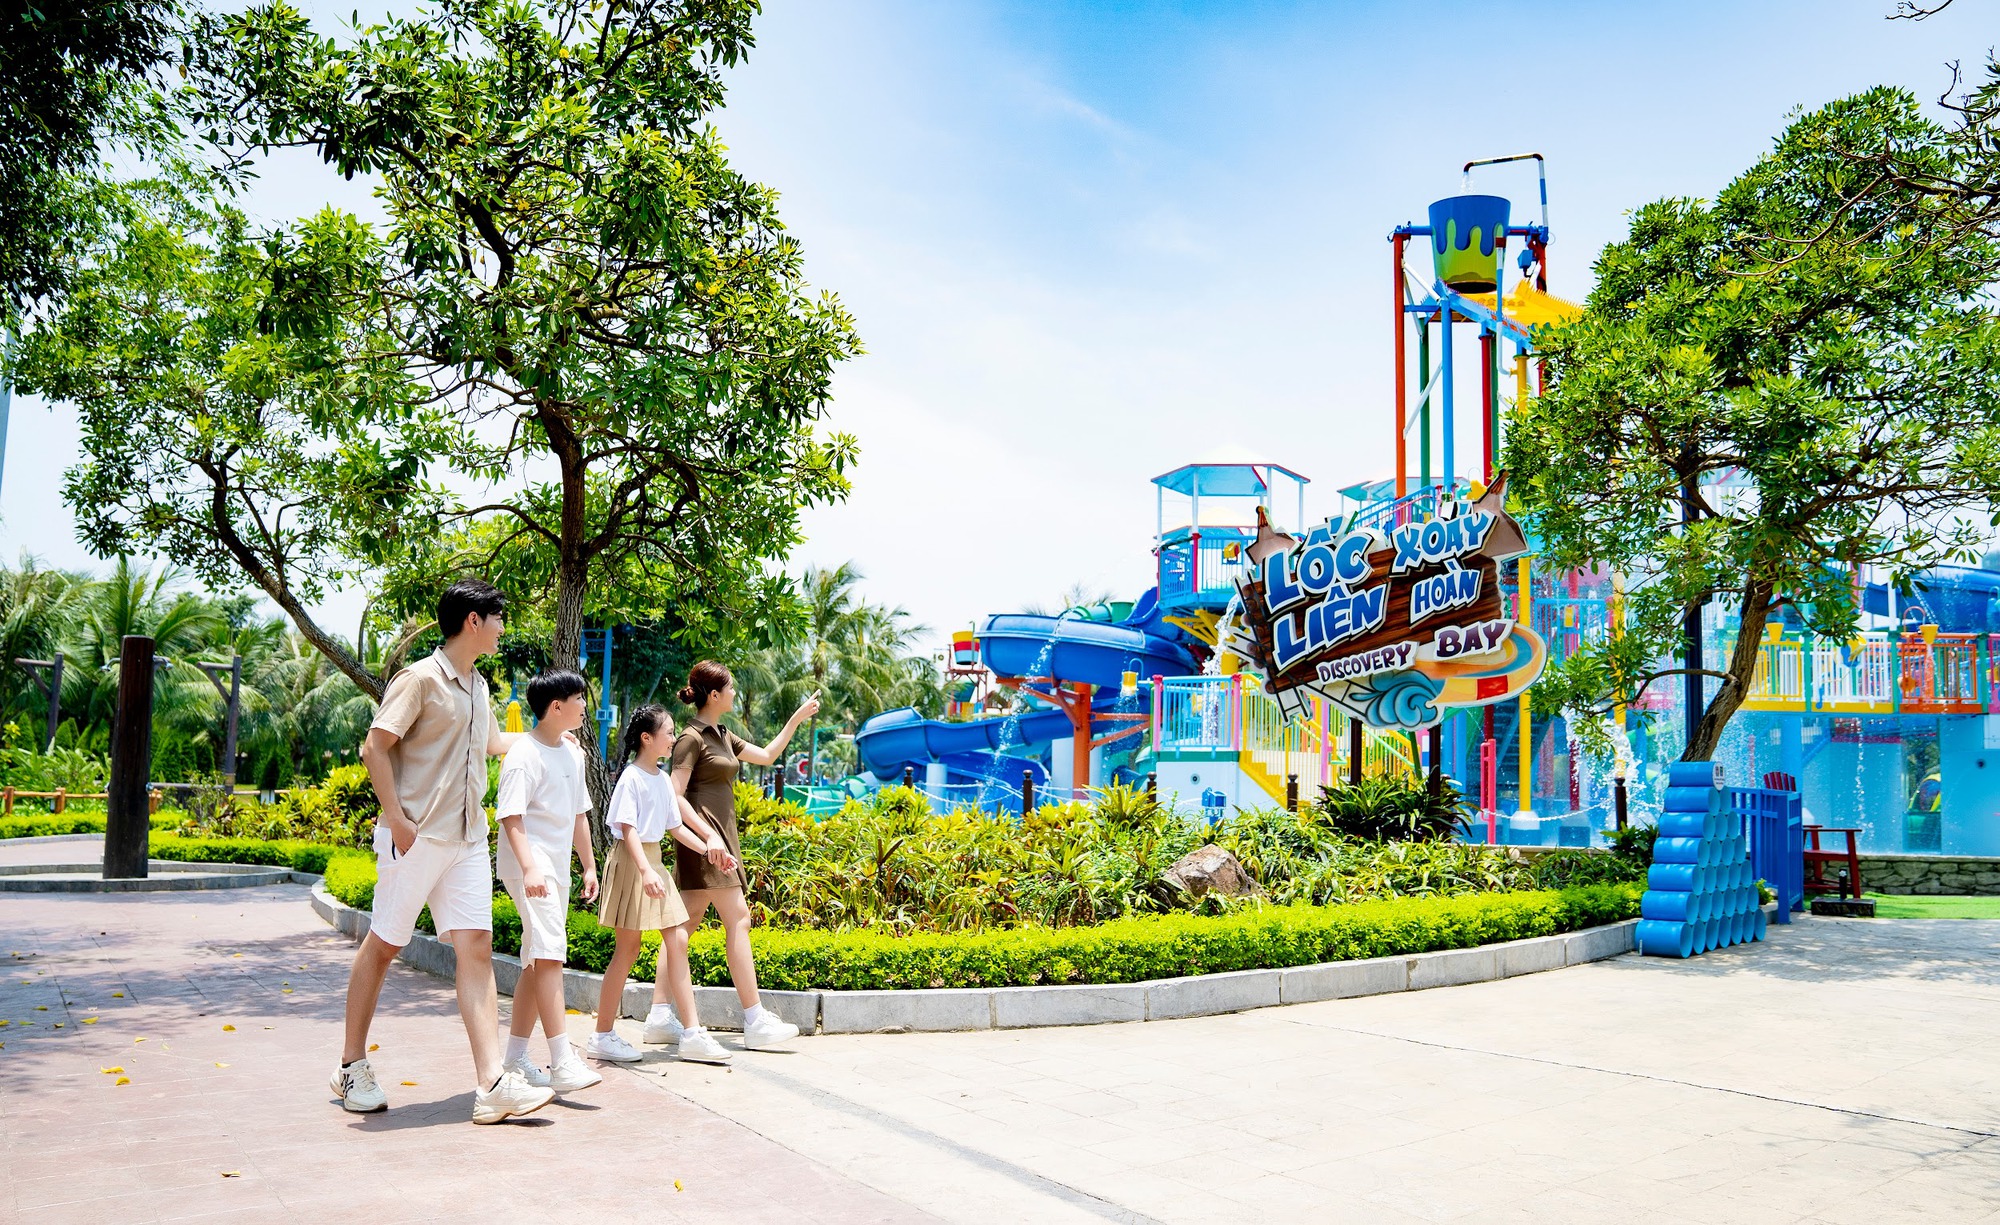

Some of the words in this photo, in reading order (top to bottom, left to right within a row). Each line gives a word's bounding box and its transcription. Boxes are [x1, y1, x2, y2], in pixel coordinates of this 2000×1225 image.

[1265, 515, 1371, 609] LỐC
[1395, 502, 1490, 568] XOÁY
[1275, 584, 1386, 665] LIÊN
[1414, 561, 1479, 615] HOÀN
[1318, 643, 1412, 683] DISCOVERY
[1437, 622, 1508, 658] BAY
